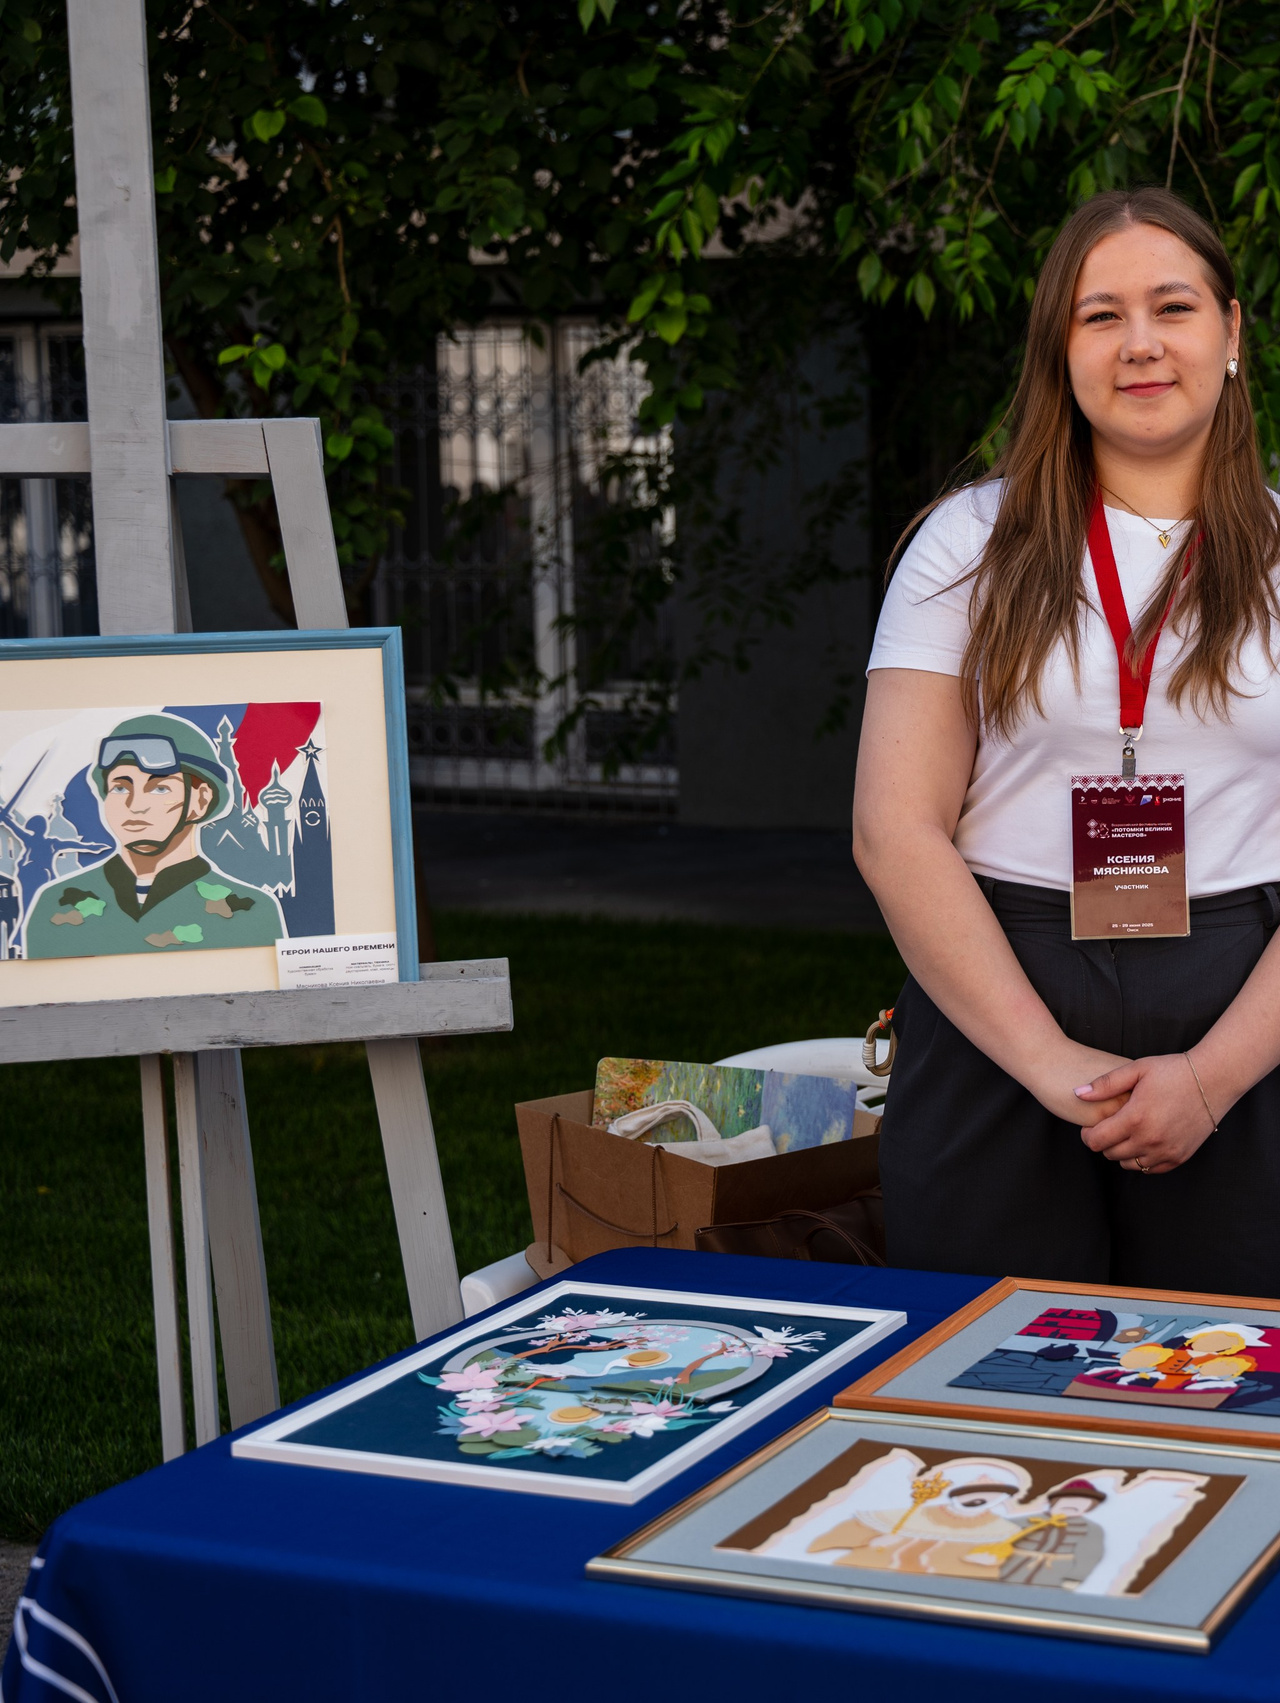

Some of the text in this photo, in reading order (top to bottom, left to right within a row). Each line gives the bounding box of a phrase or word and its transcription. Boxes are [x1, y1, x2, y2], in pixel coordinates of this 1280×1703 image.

[1107, 855, 1155, 864] КСЕНИЯ
[1093, 866, 1170, 876] МЯСНИКОВА
[312, 946, 350, 954] НАШЕГО
[352, 943, 395, 952] ВРЕМЕНИ
